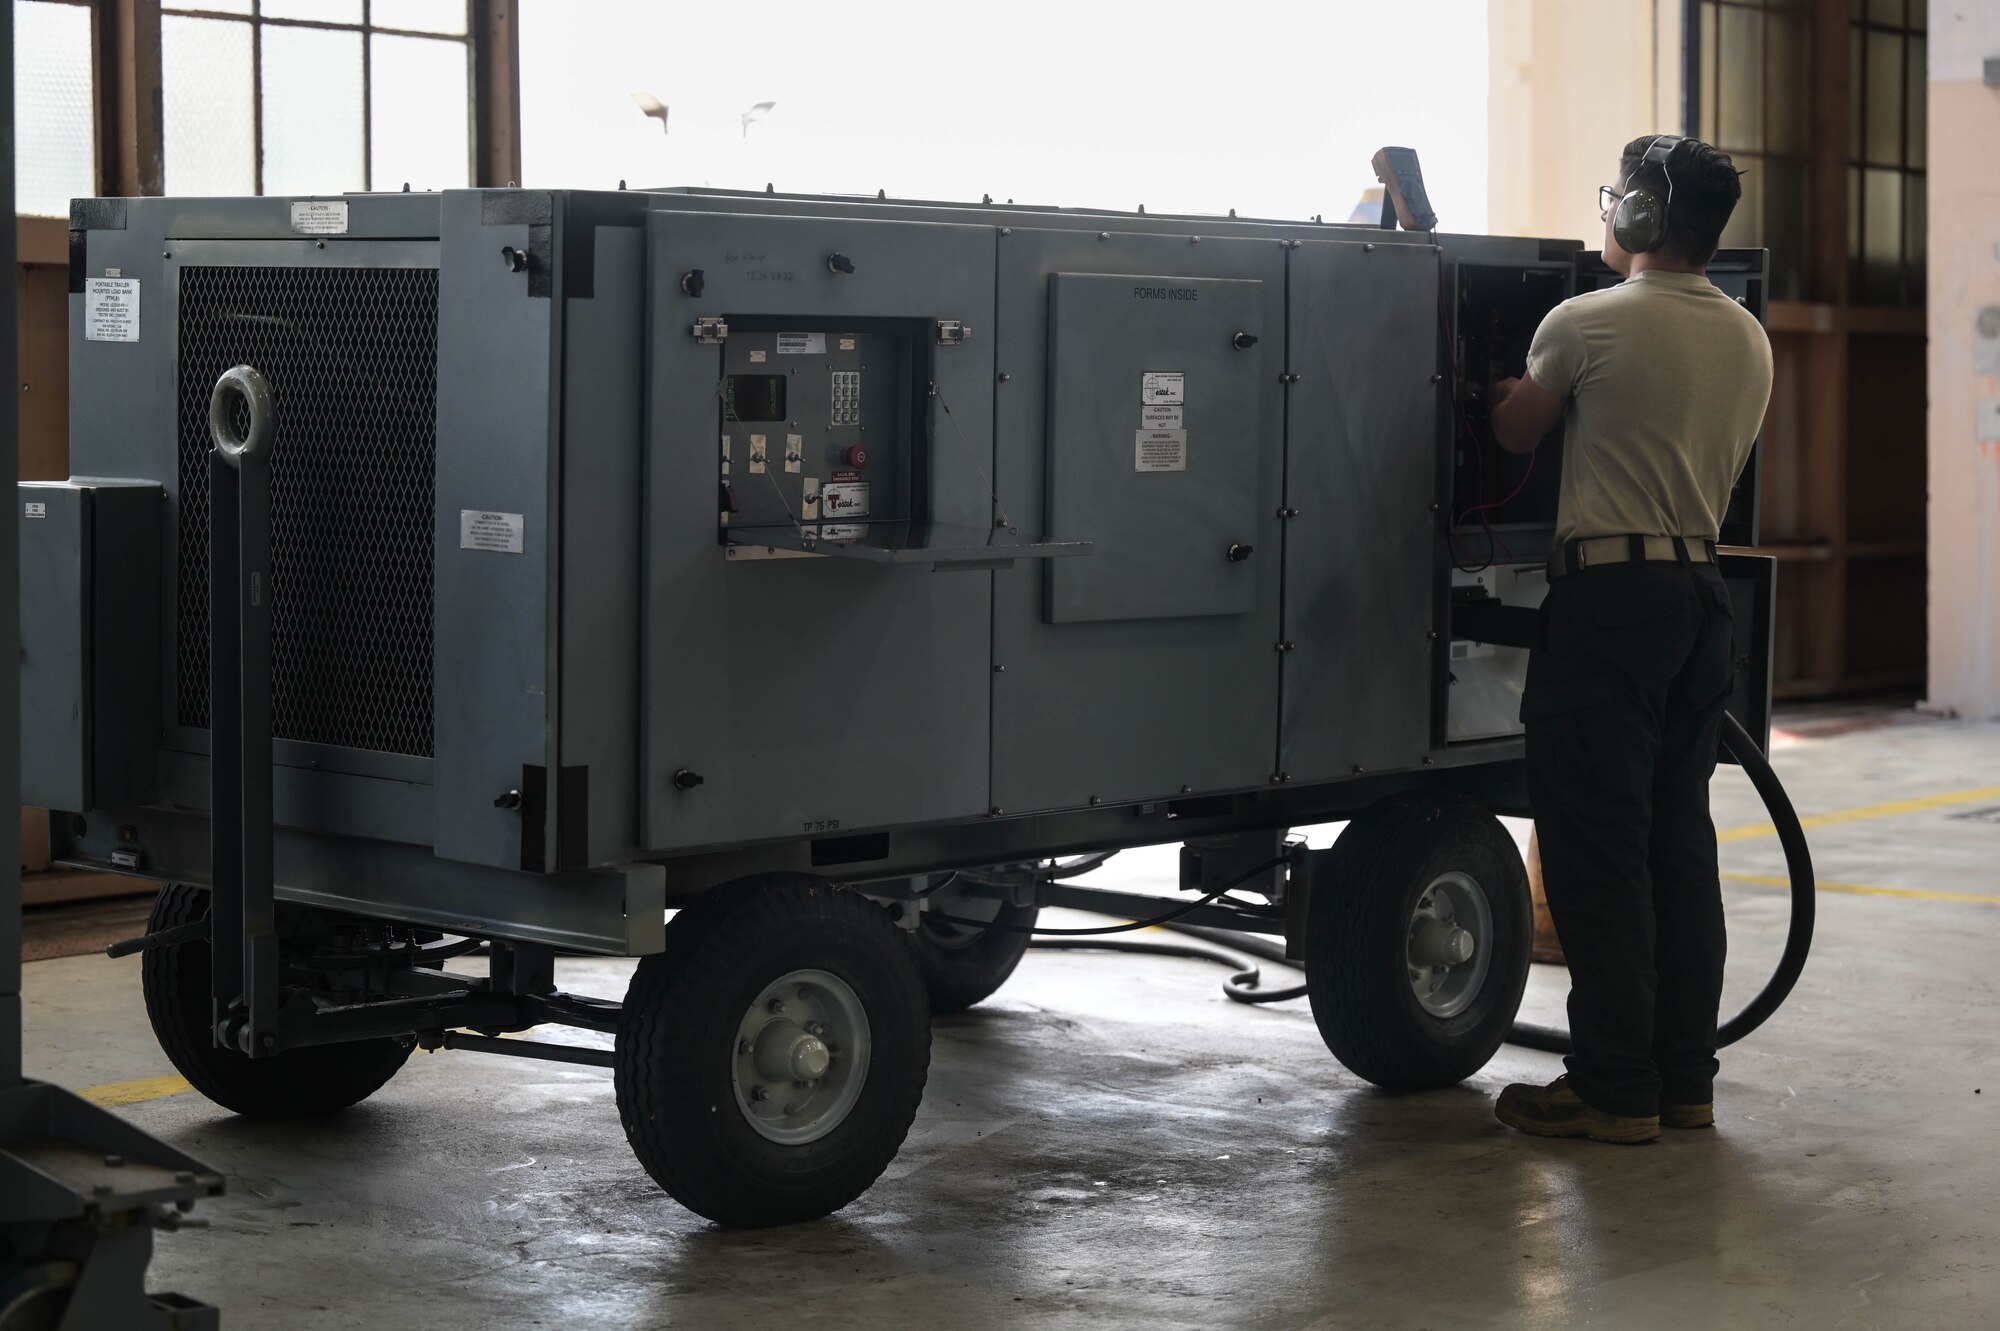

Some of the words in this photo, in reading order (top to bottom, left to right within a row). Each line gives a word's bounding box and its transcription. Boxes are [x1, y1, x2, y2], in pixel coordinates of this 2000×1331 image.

[1133, 287, 1166, 300] FORMS
[1168, 288, 1198, 301] INSIDE
[803, 822, 812, 832] TP
[815, 821, 825, 831] 75
[827, 819, 839, 830] PSI
